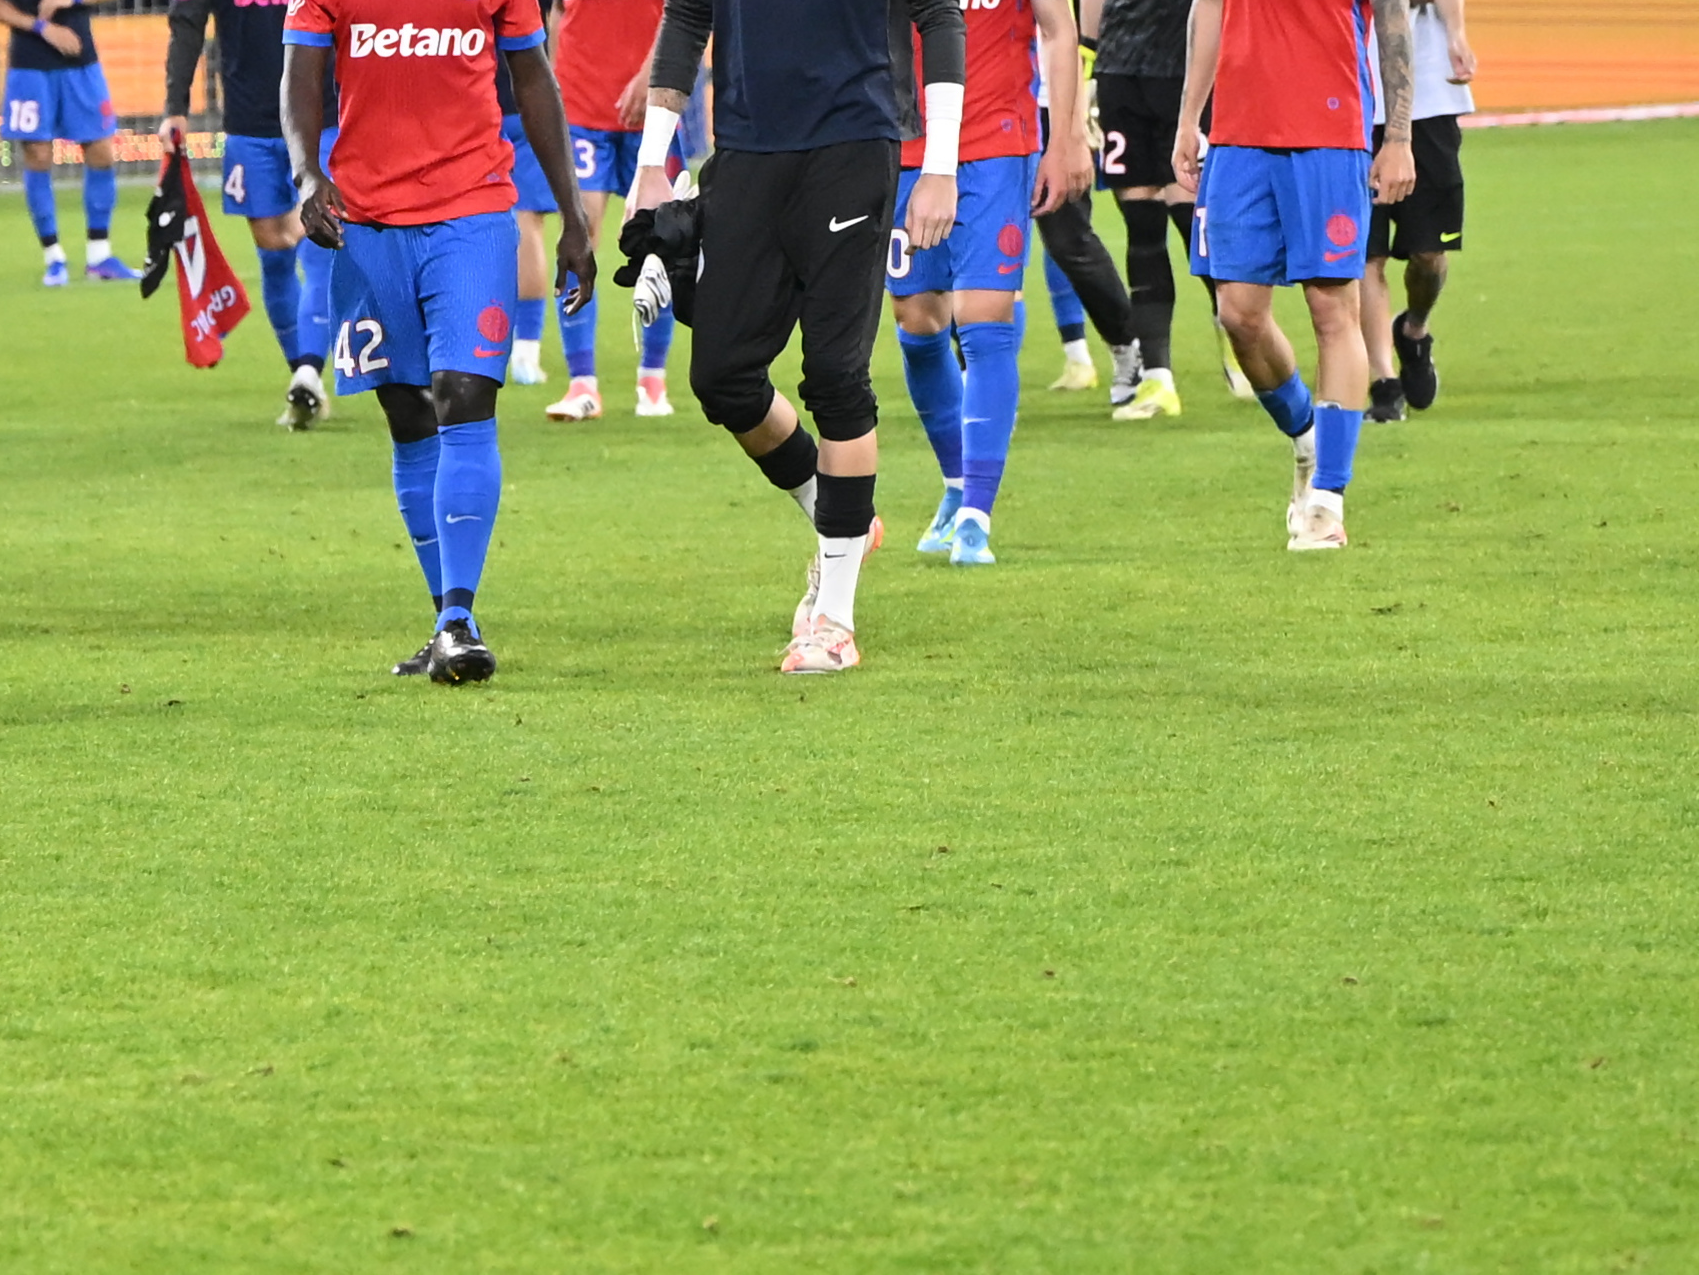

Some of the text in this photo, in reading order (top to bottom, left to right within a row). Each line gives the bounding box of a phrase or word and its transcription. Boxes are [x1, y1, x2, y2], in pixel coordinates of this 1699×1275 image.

[350, 23, 486, 59] Betano
[9, 99, 40, 133] 16
[225, 163, 246, 204] 4
[334, 318, 390, 378] 42
